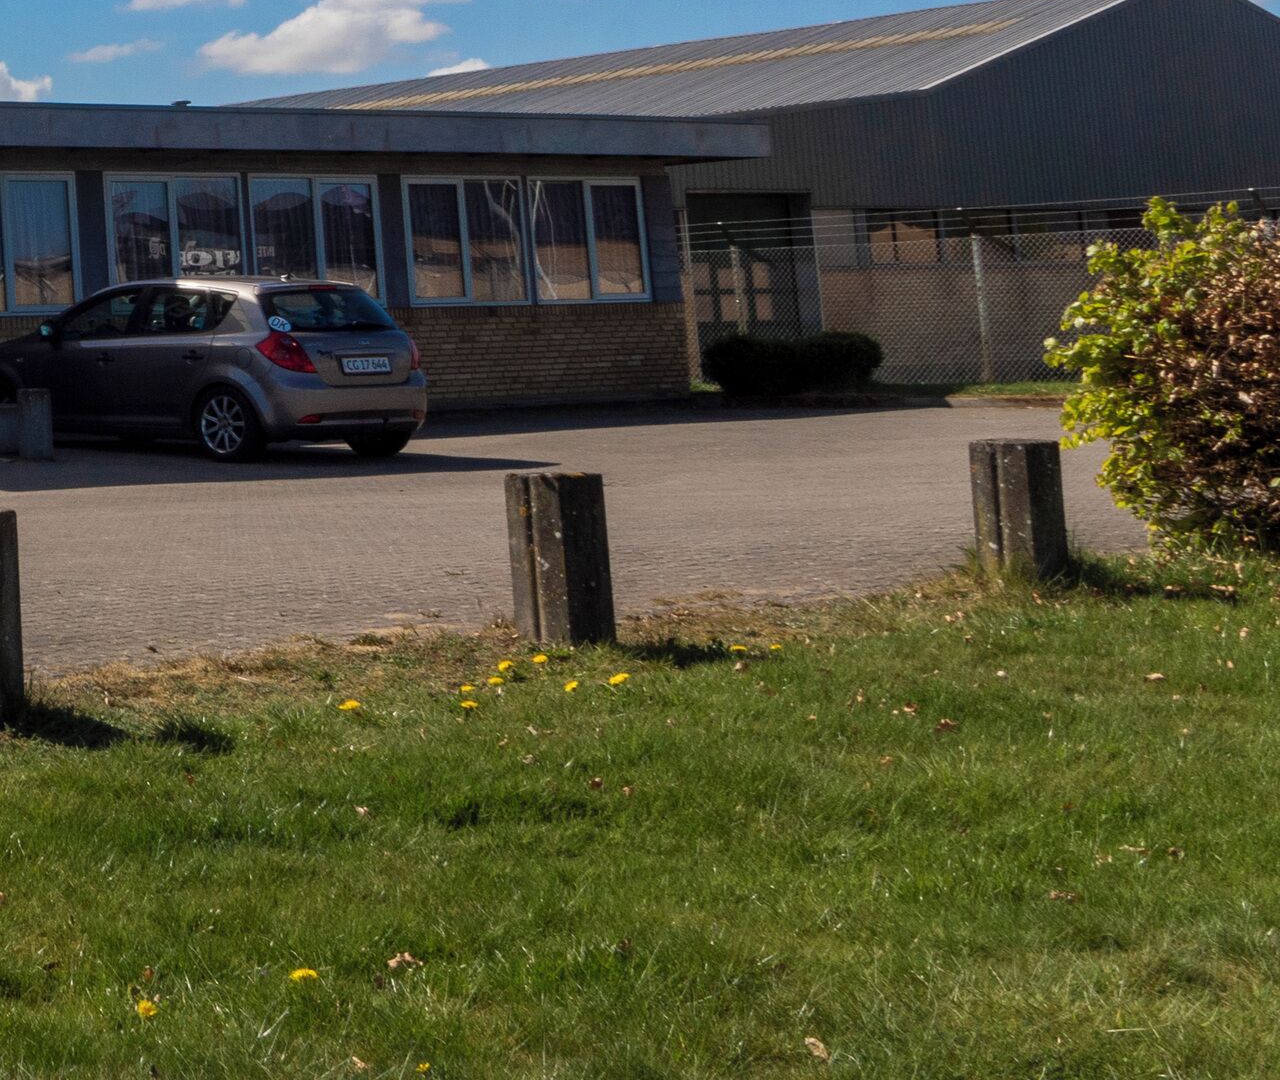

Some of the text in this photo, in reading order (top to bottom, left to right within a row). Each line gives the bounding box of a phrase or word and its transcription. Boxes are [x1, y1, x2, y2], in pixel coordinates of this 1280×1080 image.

[271, 318, 290, 330] DK
[346, 359, 360, 371] CG
[361, 359, 370, 370] 17
